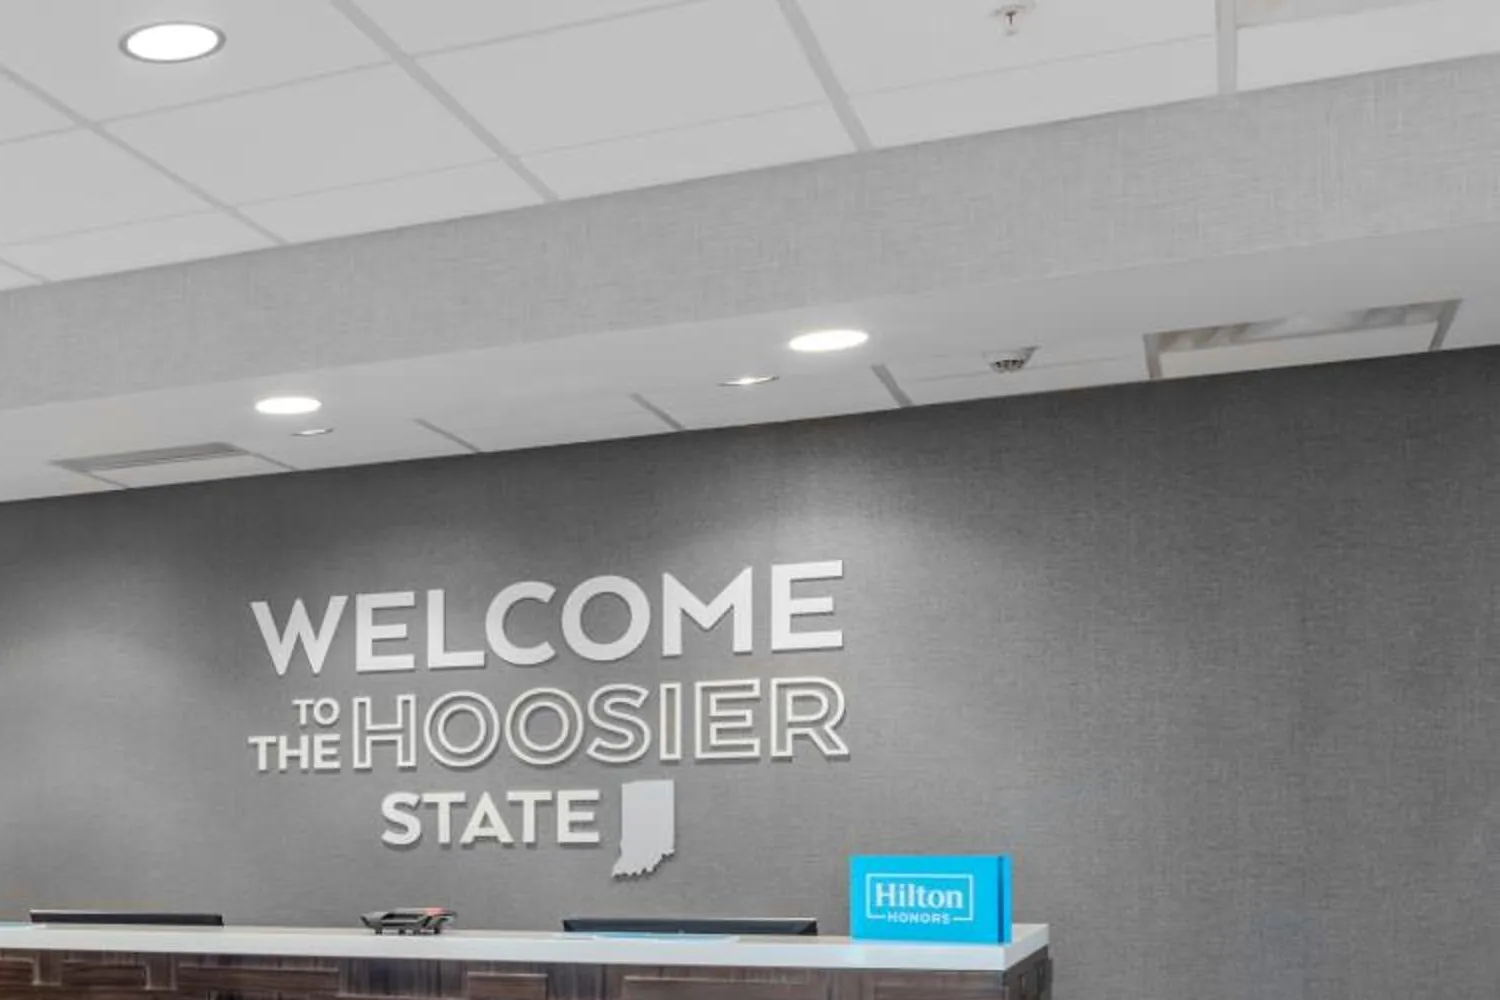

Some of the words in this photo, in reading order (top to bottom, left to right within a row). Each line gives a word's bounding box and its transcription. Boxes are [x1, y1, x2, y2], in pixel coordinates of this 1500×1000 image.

[250, 559, 845, 677] WELCOME
[248, 733, 341, 772] THE
[352, 676, 851, 770] HOOSIER
[293, 697, 341, 727] TO
[380, 788, 601, 846] STATE
[875, 882, 964, 909] Hilton
[887, 911, 950, 925] HONORS
